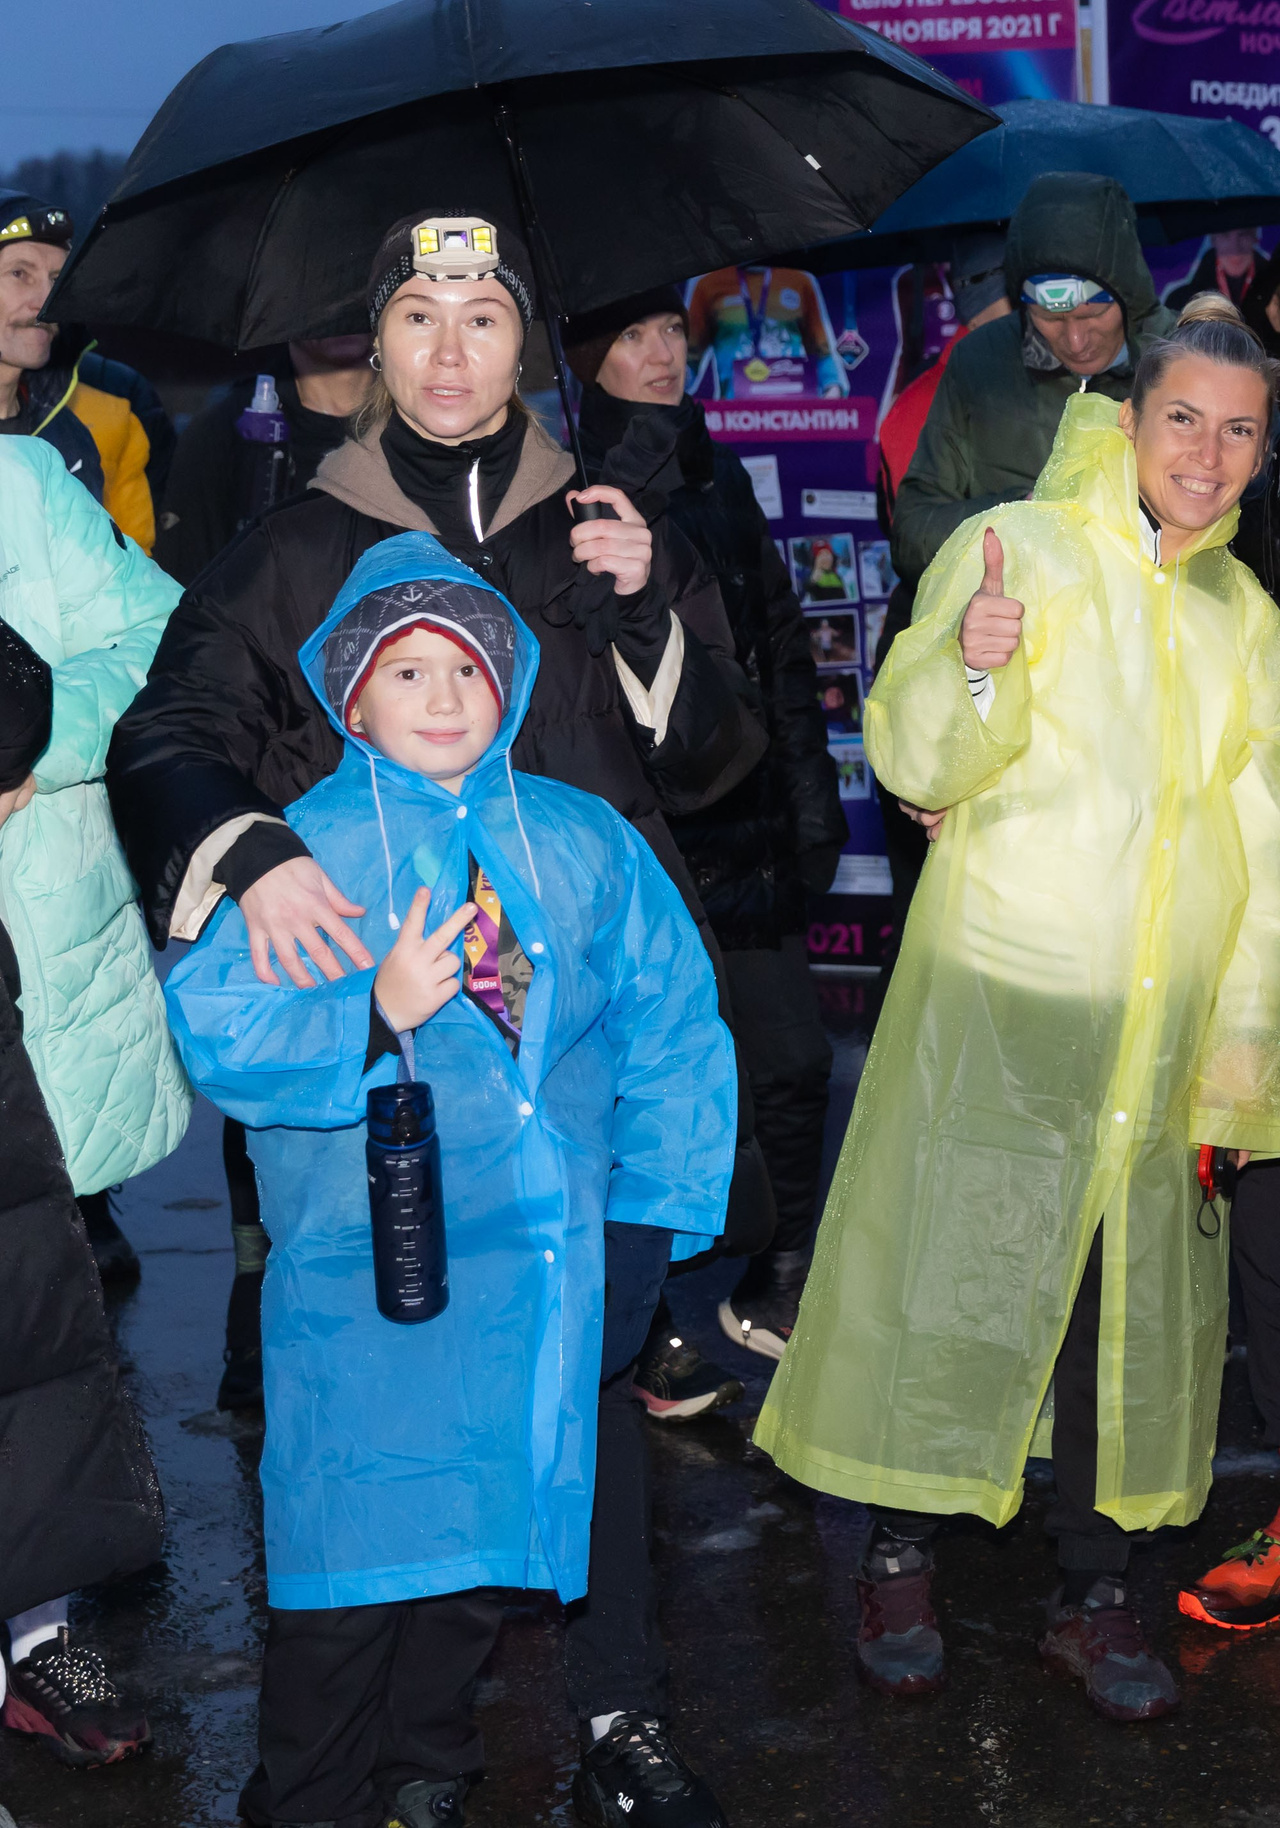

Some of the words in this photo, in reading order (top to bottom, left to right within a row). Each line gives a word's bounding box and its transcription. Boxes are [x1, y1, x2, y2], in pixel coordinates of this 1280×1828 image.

[884, 17, 982, 42] НОЯБРЯ
[985, 14, 1043, 39] 2021
[725, 409, 859, 431] КОНСТАНТИН
[807, 922, 863, 955] 021
[617, 1792, 634, 1813] 360
